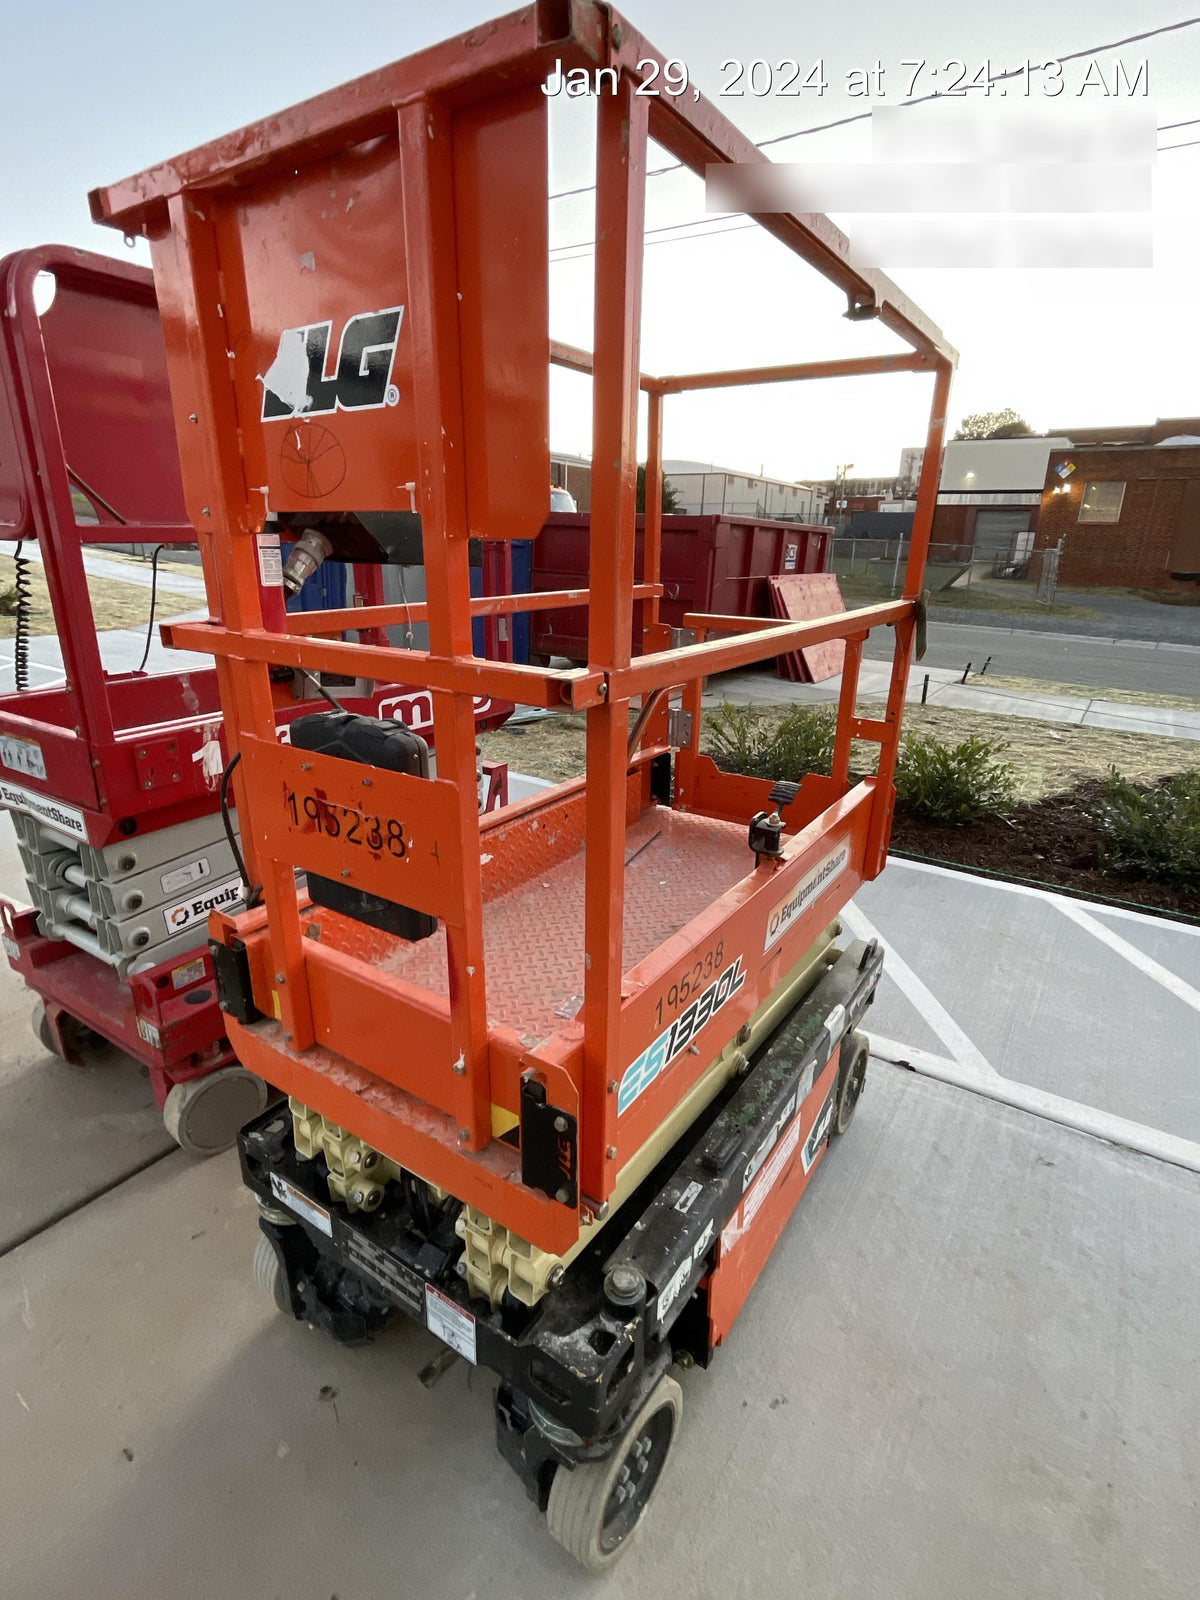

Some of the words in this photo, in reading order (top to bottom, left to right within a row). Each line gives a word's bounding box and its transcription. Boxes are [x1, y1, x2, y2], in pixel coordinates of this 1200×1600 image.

[287, 791, 407, 858] 195238
[780, 849, 846, 924] EquipmentShare
[655, 940, 724, 1025] 195238
